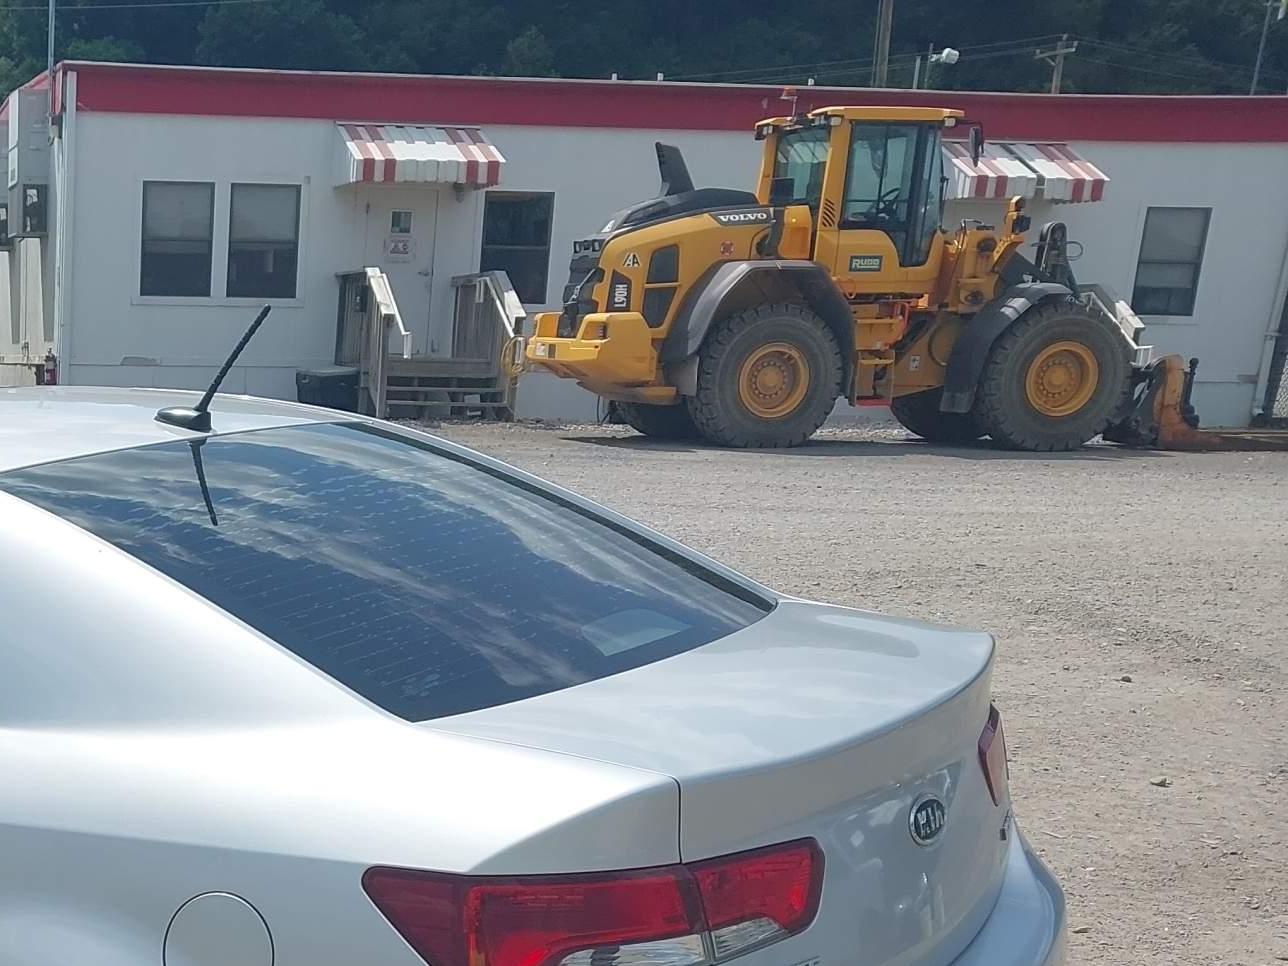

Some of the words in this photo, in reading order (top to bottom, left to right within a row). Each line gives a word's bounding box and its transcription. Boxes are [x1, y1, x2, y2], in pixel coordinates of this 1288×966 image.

[717, 212, 768, 222] VOLVO
[613, 283, 628, 308] L90H
[916, 802, 944, 839] KIA
